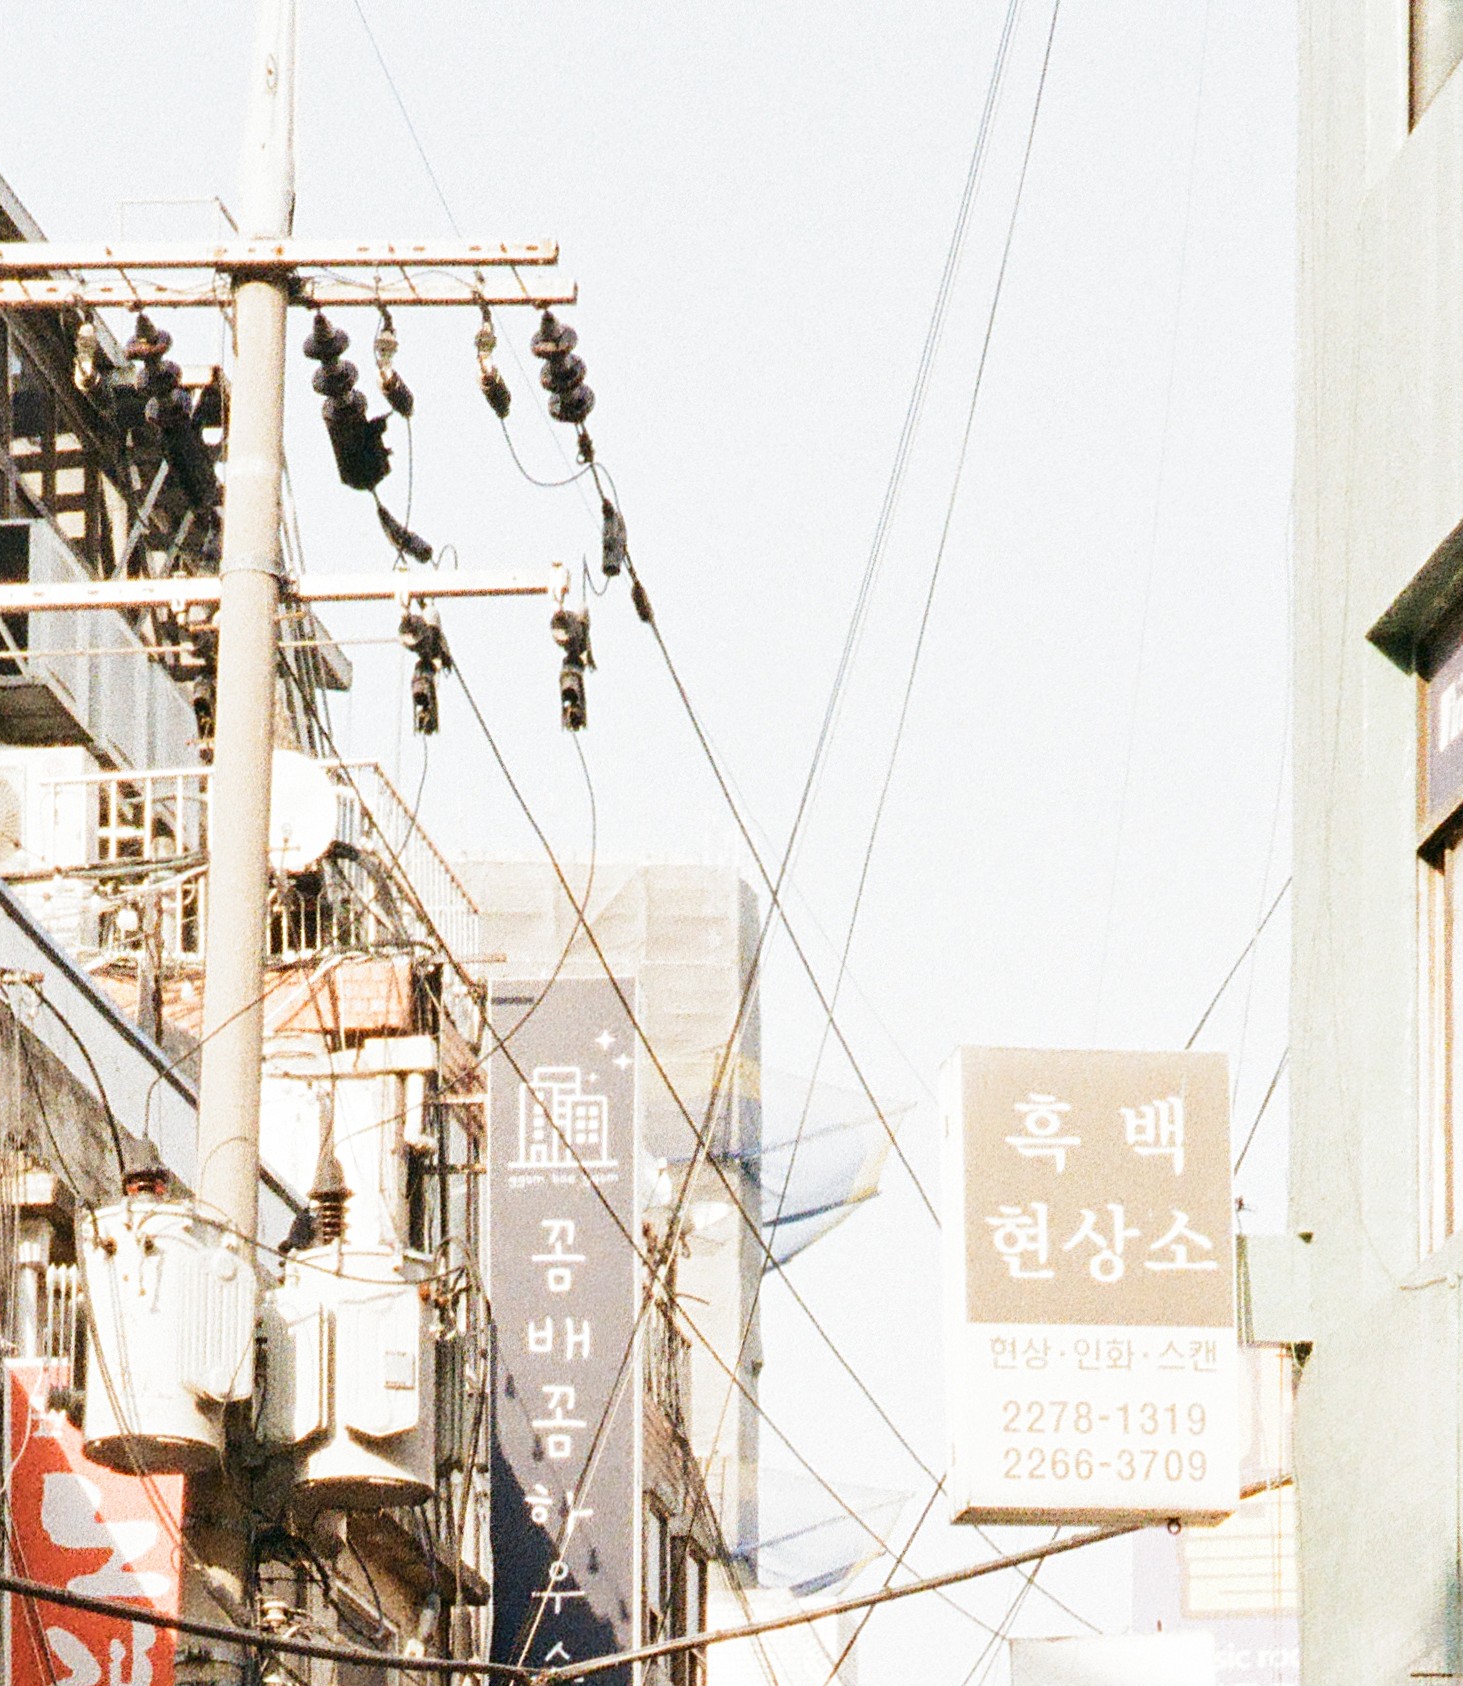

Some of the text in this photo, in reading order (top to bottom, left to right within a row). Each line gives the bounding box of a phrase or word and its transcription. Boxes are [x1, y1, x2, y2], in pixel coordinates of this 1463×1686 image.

[1004, 1093, 1187, 1175] 흑백
[984, 1202, 1220, 1282] 현상소
[1002, 1400, 1208, 1436] 2278-1319
[1004, 1447, 1209, 1482] 2266-3709
